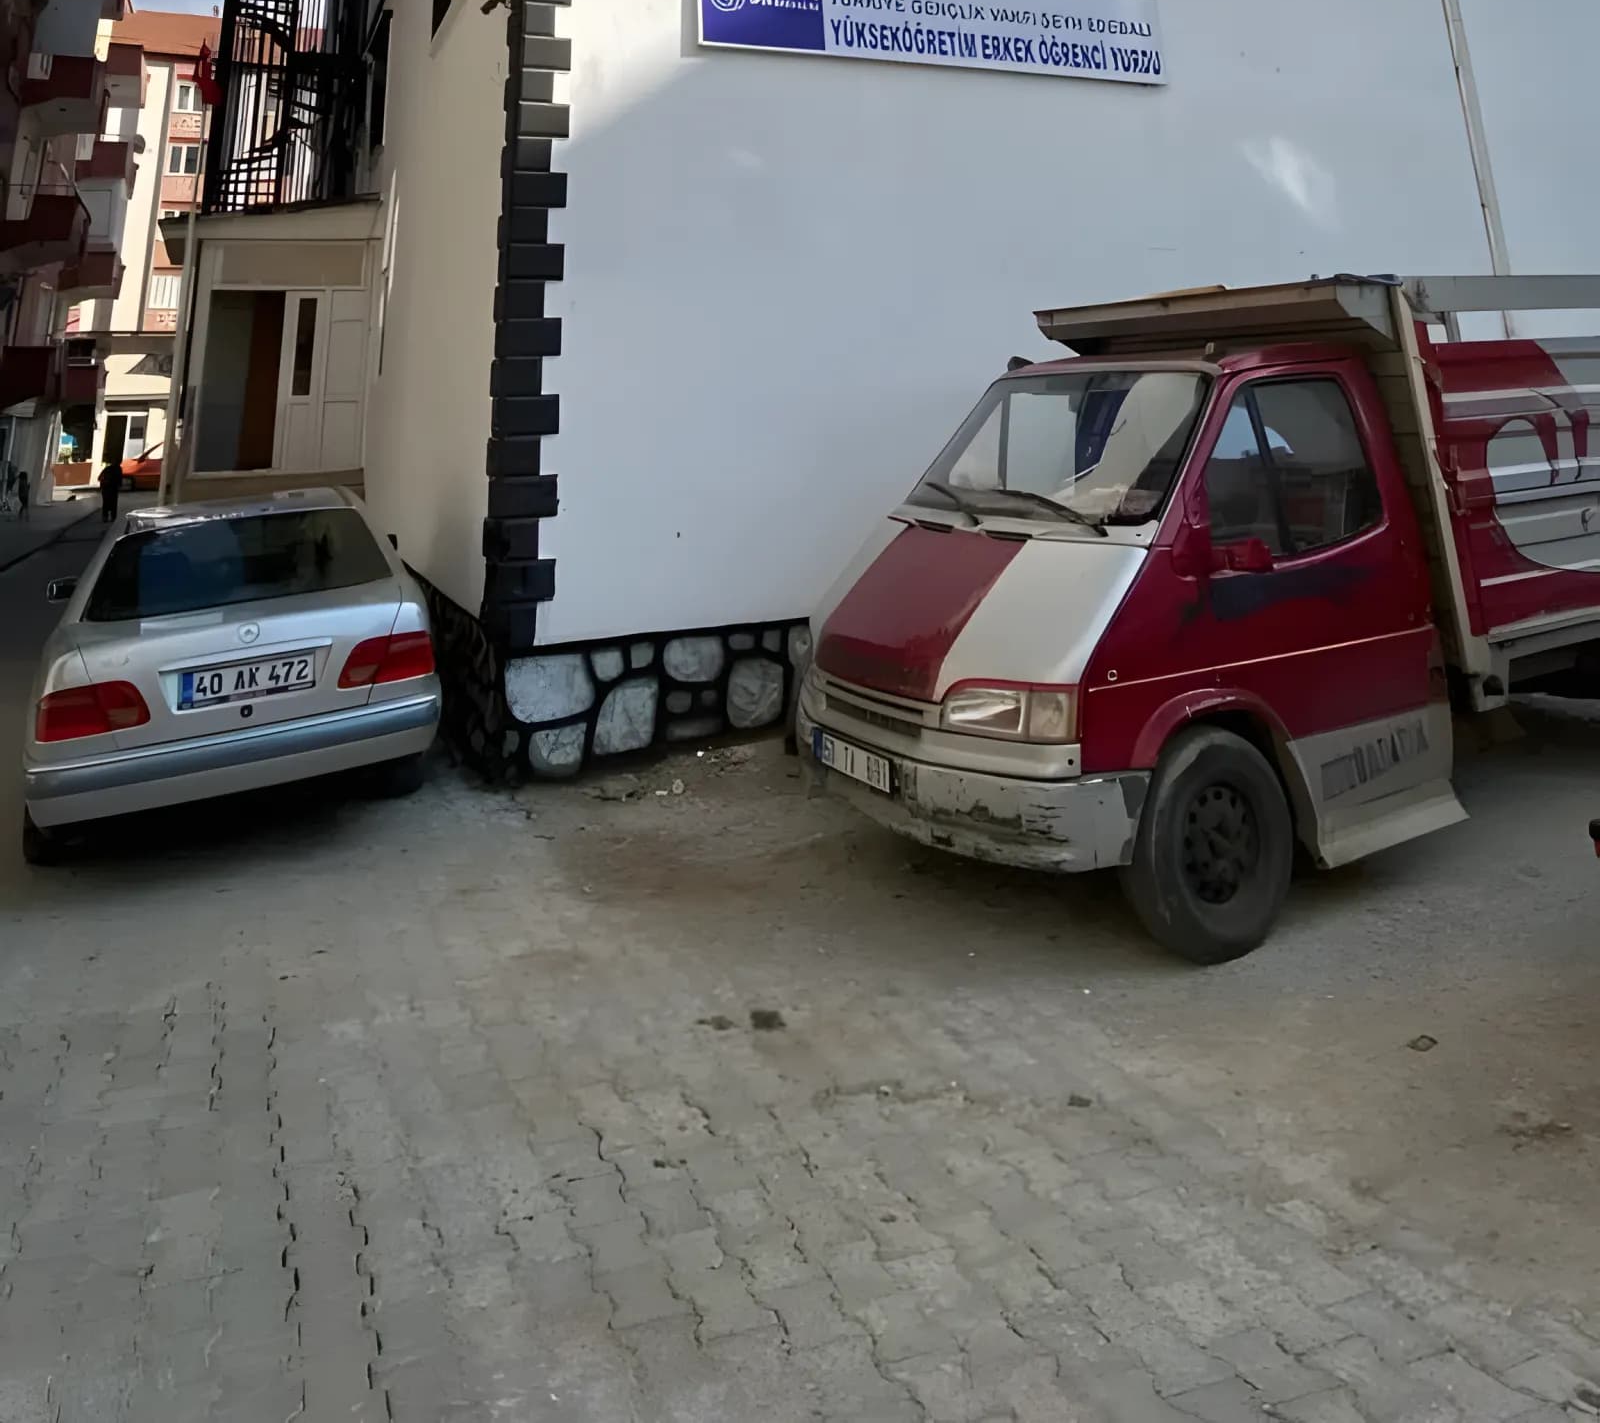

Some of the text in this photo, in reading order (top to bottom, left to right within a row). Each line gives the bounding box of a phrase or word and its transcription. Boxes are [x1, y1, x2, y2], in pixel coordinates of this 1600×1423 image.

[830, 14, 978, 58] YÜKSEKÖĞRETİM
[981, 34, 1037, 64] ERKEK
[1039, 34, 1108, 70] ÖĞRENCİ
[195, 659, 309, 697] 40 AK 472
